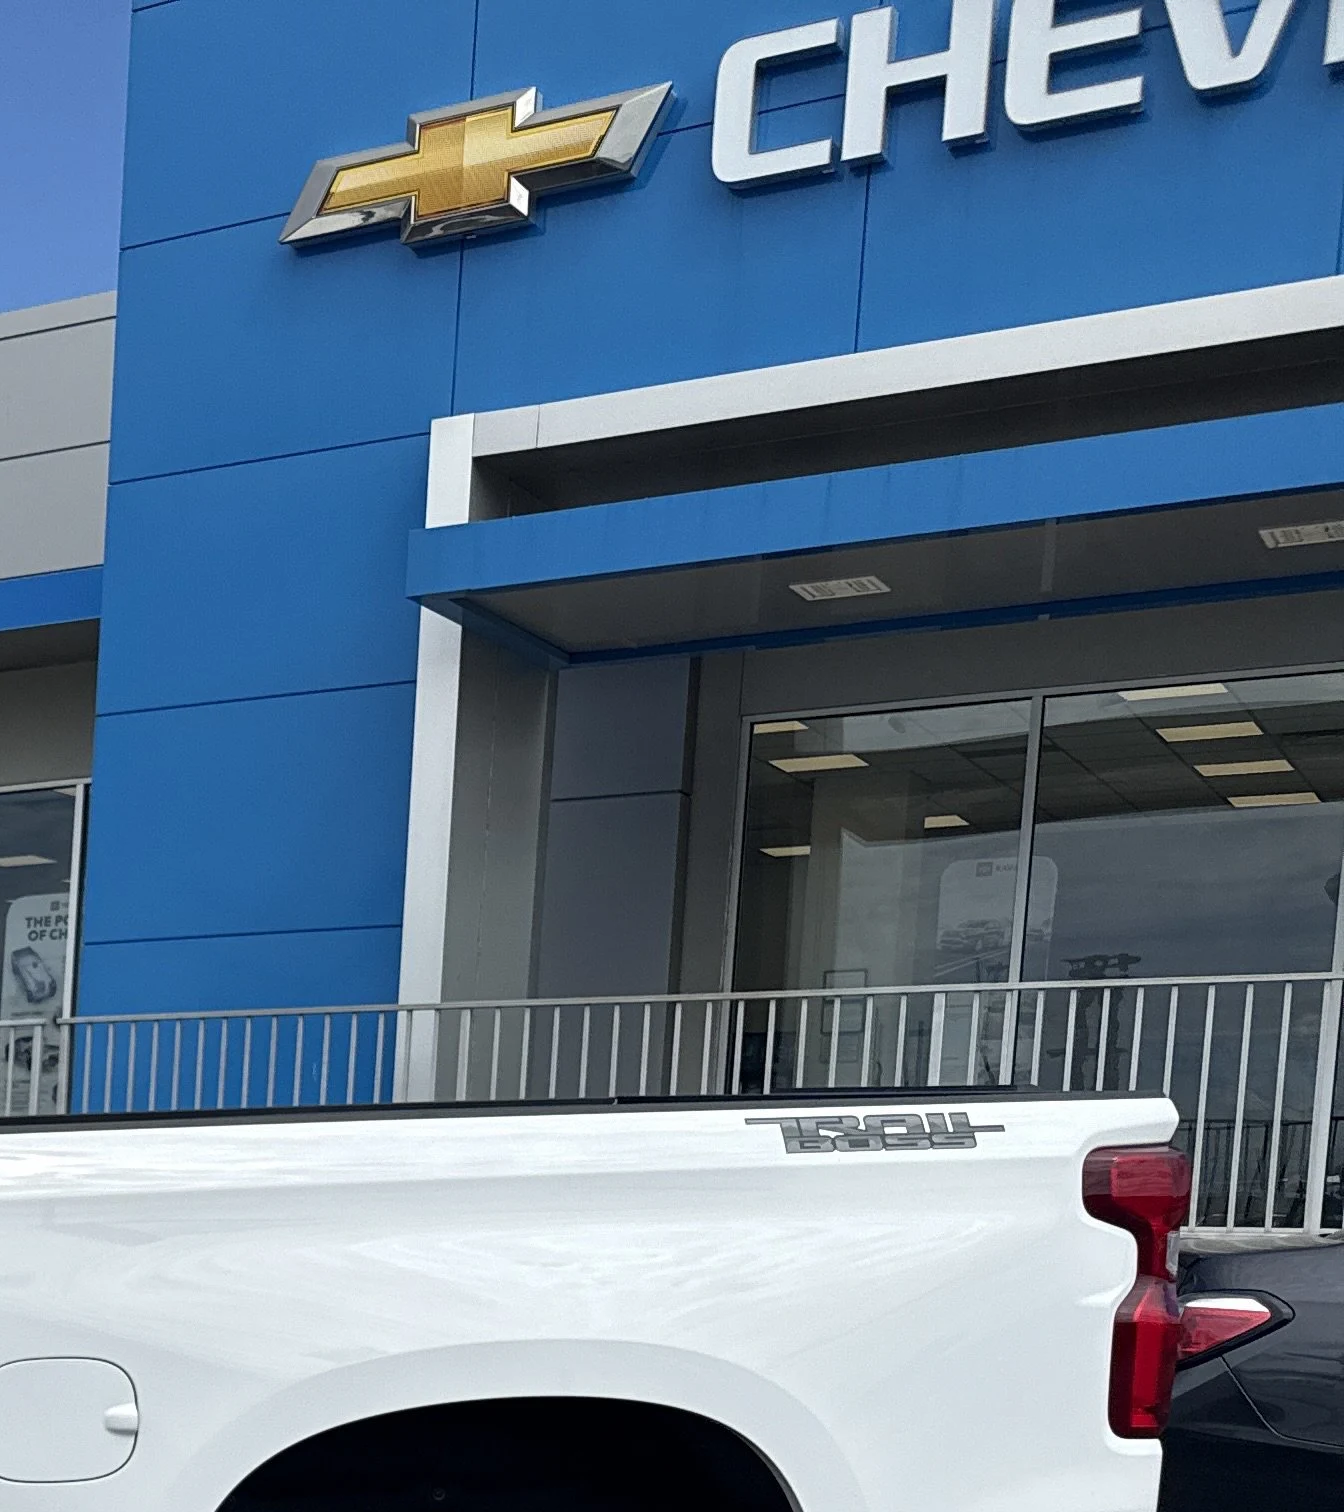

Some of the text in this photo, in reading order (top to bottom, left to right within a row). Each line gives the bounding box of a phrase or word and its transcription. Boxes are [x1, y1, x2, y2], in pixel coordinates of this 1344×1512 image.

[712, 0, 1344, 188] CHEV
[25, 916, 51, 928] THE
[28, 930, 47, 941] OF
[745, 1112, 1005, 1137] TRAIL
[785, 1133, 978, 1154] BOSS
